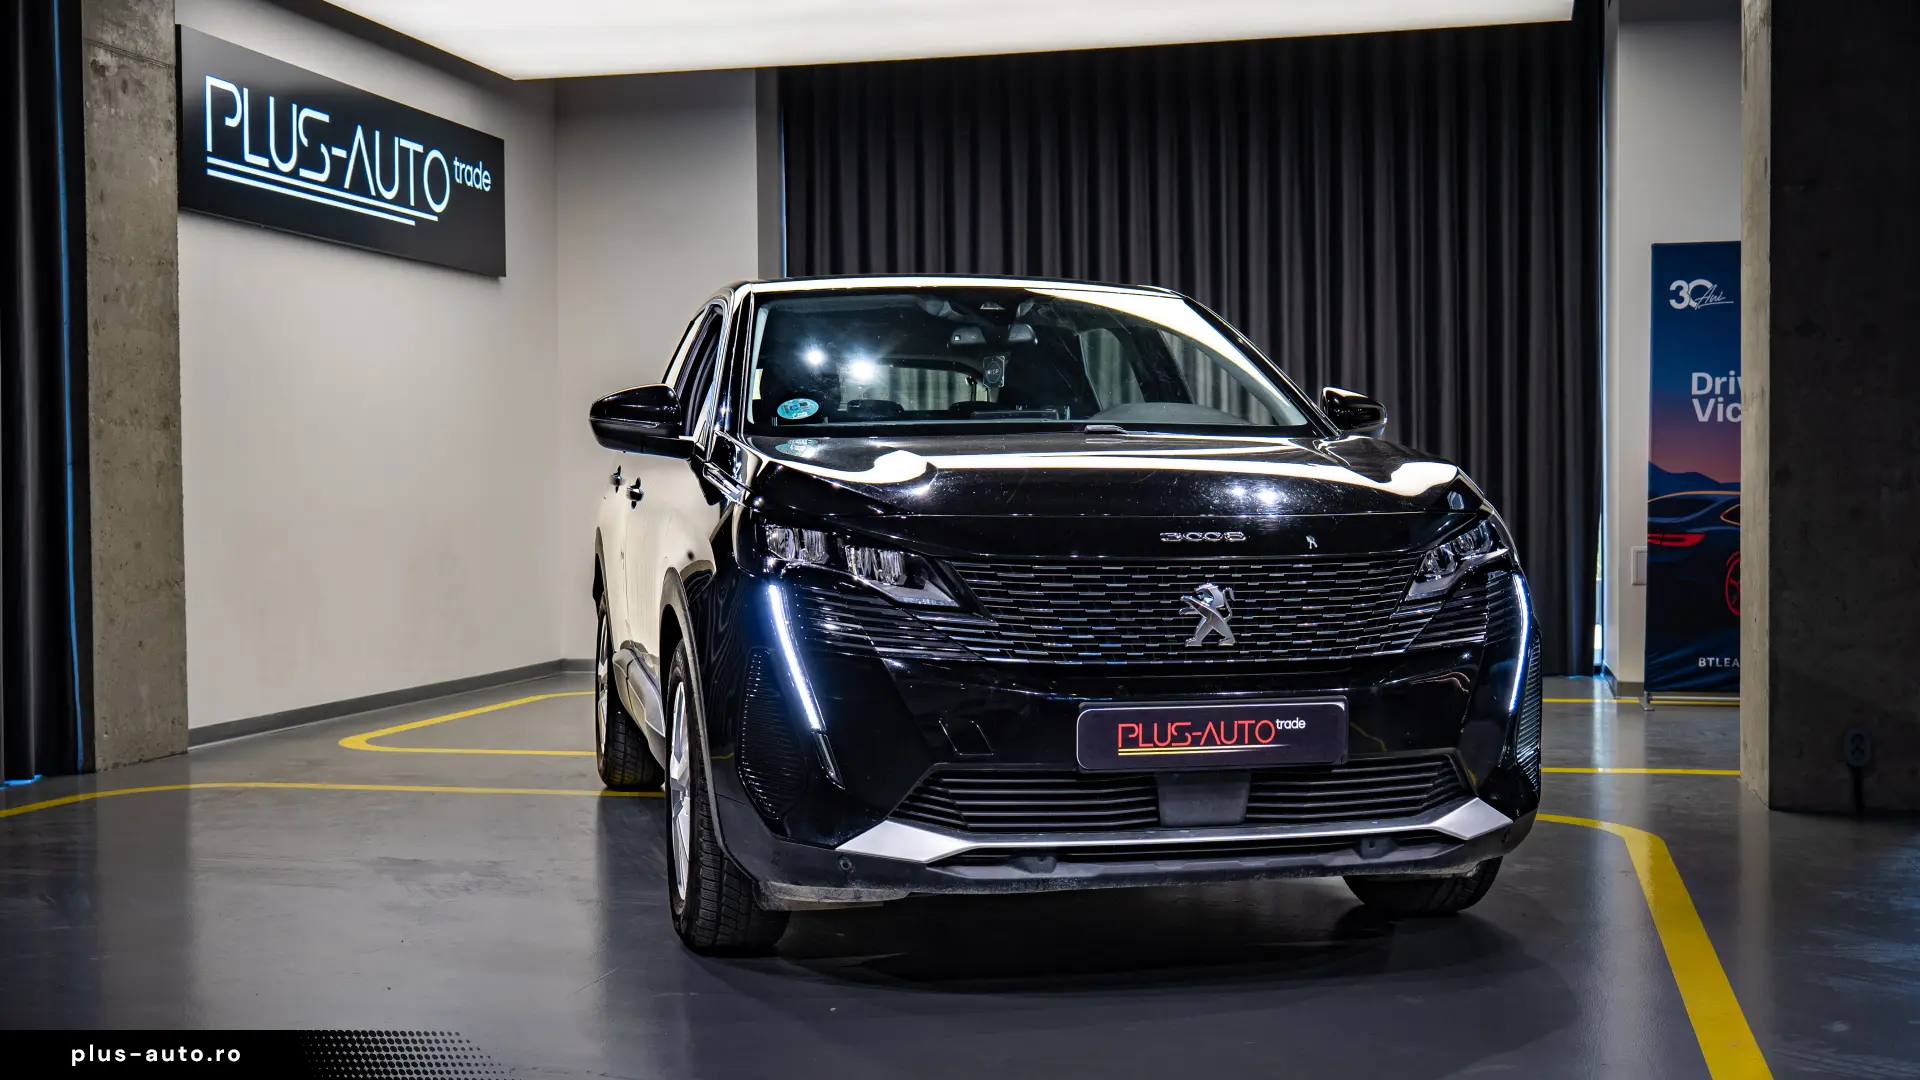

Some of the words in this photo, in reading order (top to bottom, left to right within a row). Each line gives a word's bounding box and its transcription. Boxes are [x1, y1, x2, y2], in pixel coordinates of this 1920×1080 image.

[205, 75, 450, 213] PLUS-AUTO
[453, 156, 491, 192] trade
[1159, 531, 1247, 543] 3008
[1117, 719, 1276, 748] PLUS-AUTO
[1275, 717, 1306, 730] trade
